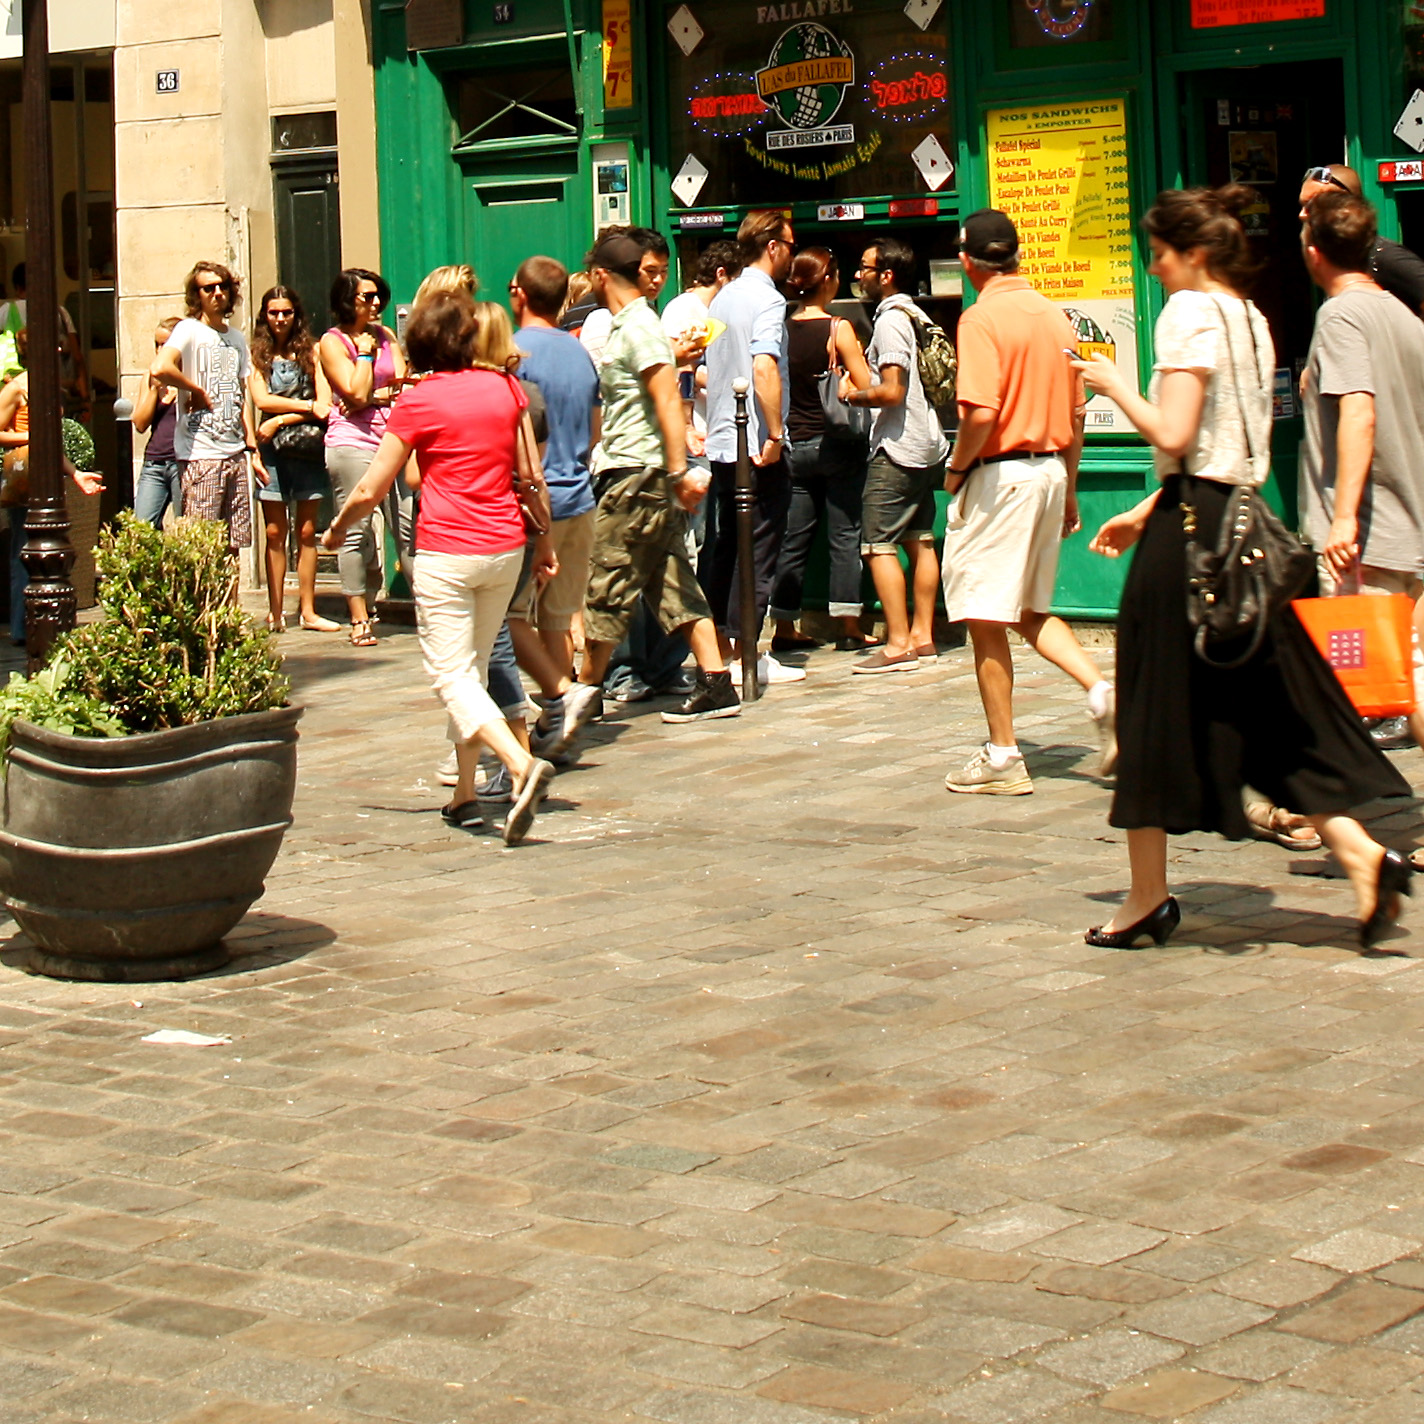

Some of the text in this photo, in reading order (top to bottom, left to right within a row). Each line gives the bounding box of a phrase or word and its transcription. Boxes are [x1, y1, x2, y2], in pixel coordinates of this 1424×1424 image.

[797, 62, 850, 83] FALLAFEL
[159, 73, 176, 89] 36
[1000, 105, 1119, 122] NOS SANDWICHS
[1094, 413, 1114, 424] PARIS
